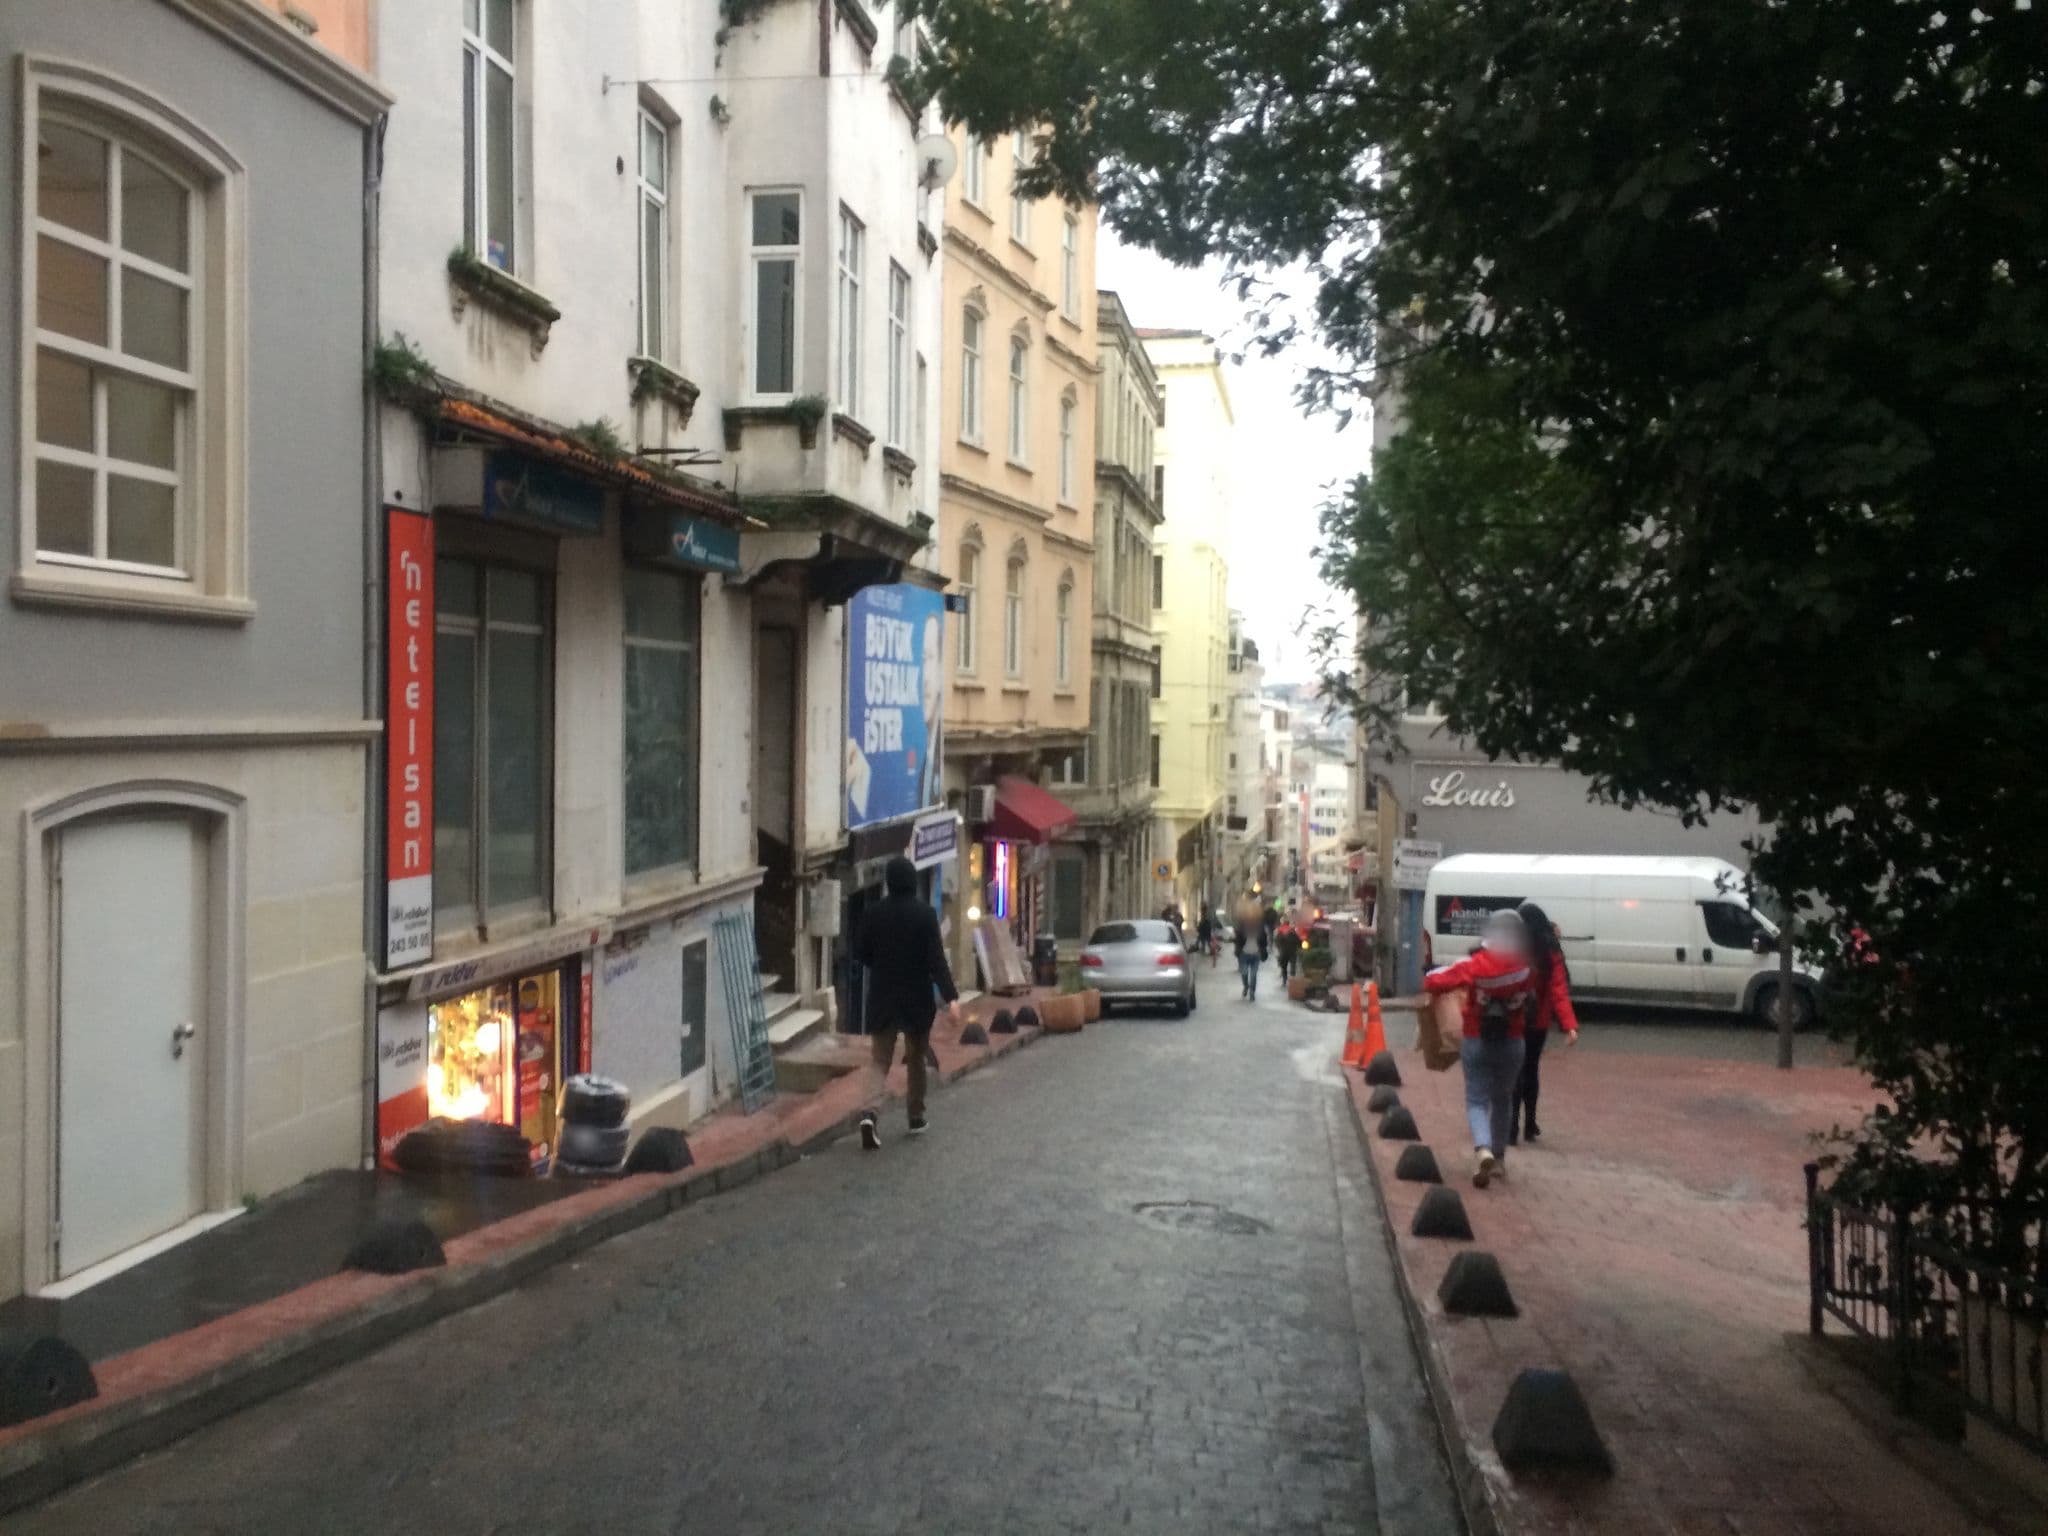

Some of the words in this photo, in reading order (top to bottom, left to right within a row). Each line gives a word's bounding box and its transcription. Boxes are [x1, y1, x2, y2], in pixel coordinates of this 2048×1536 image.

[865, 613, 913, 661] BÜYÜK
[864, 661, 919, 705] USTALIK
[1422, 769, 1515, 807] Louis
